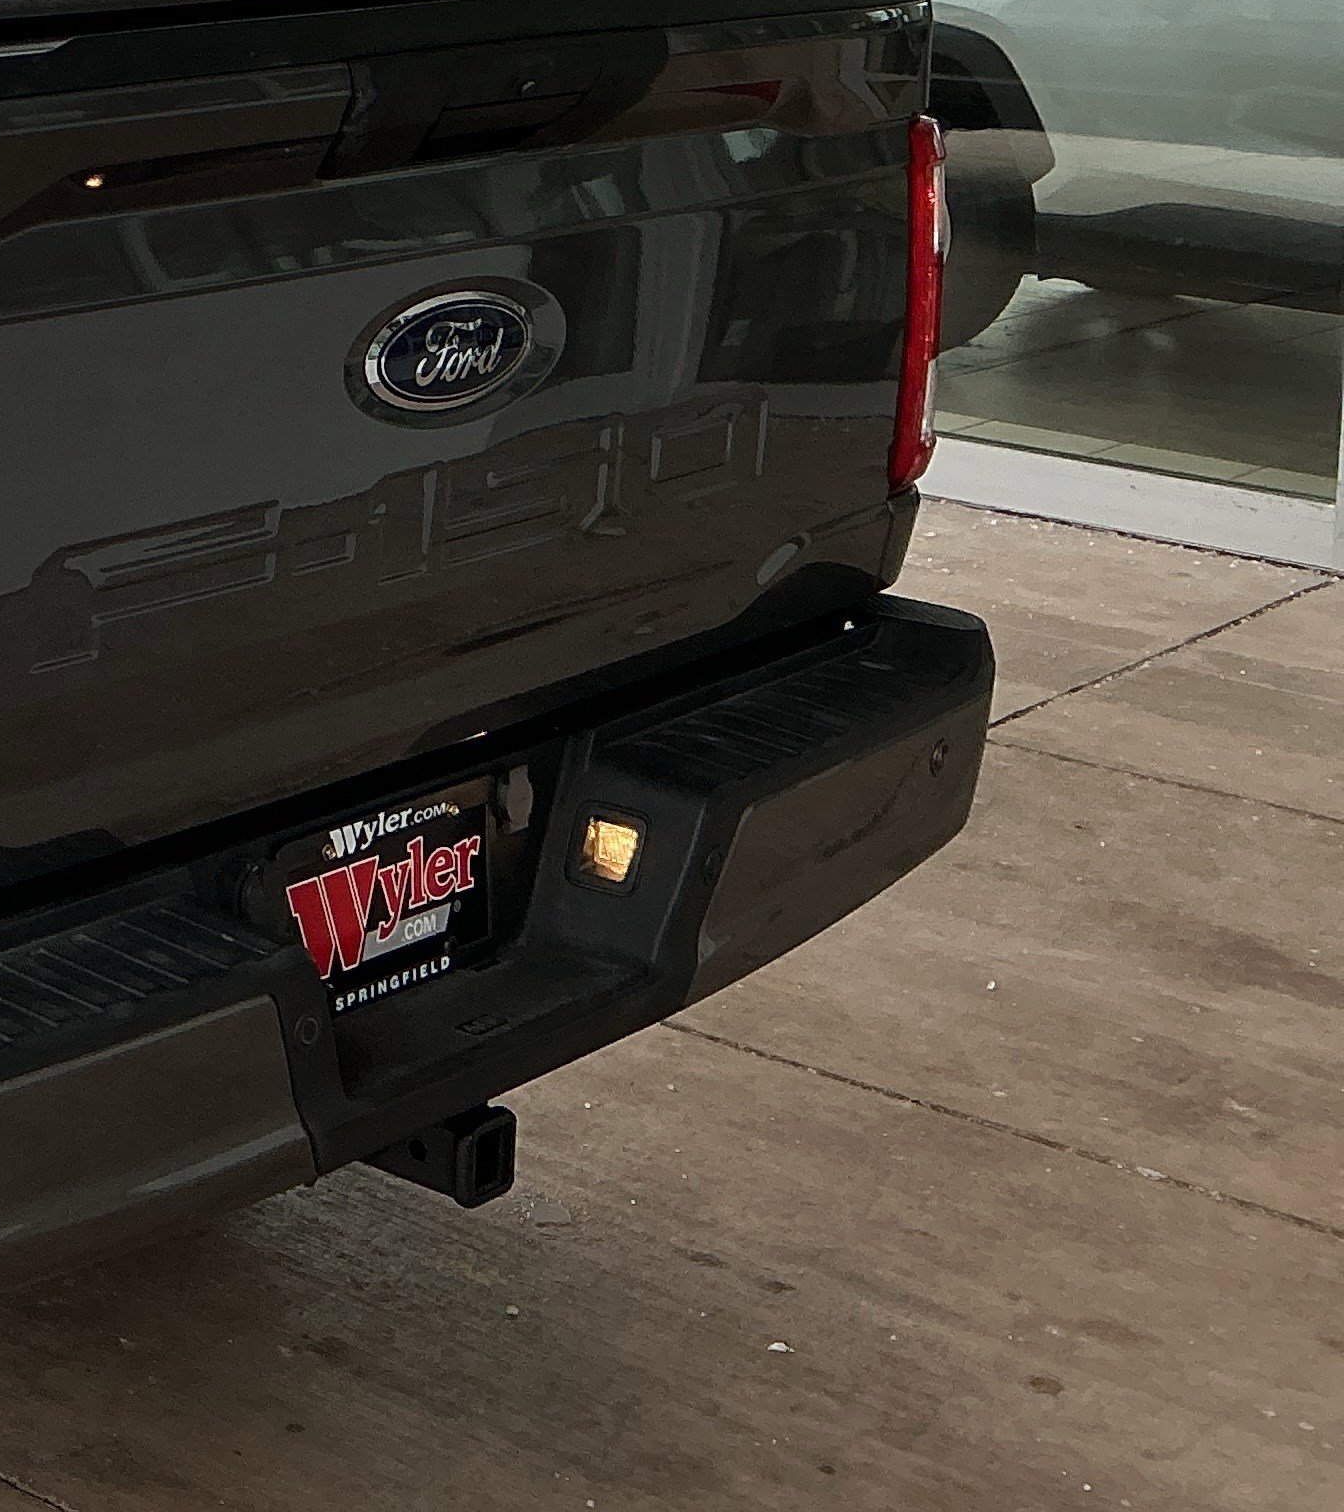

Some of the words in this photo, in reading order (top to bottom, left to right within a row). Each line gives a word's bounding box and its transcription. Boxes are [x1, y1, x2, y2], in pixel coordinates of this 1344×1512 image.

[415, 317, 504, 387] Ford
[286, 835, 480, 980] Wyler
[335, 955, 450, 1012] SPRINGFIELD
